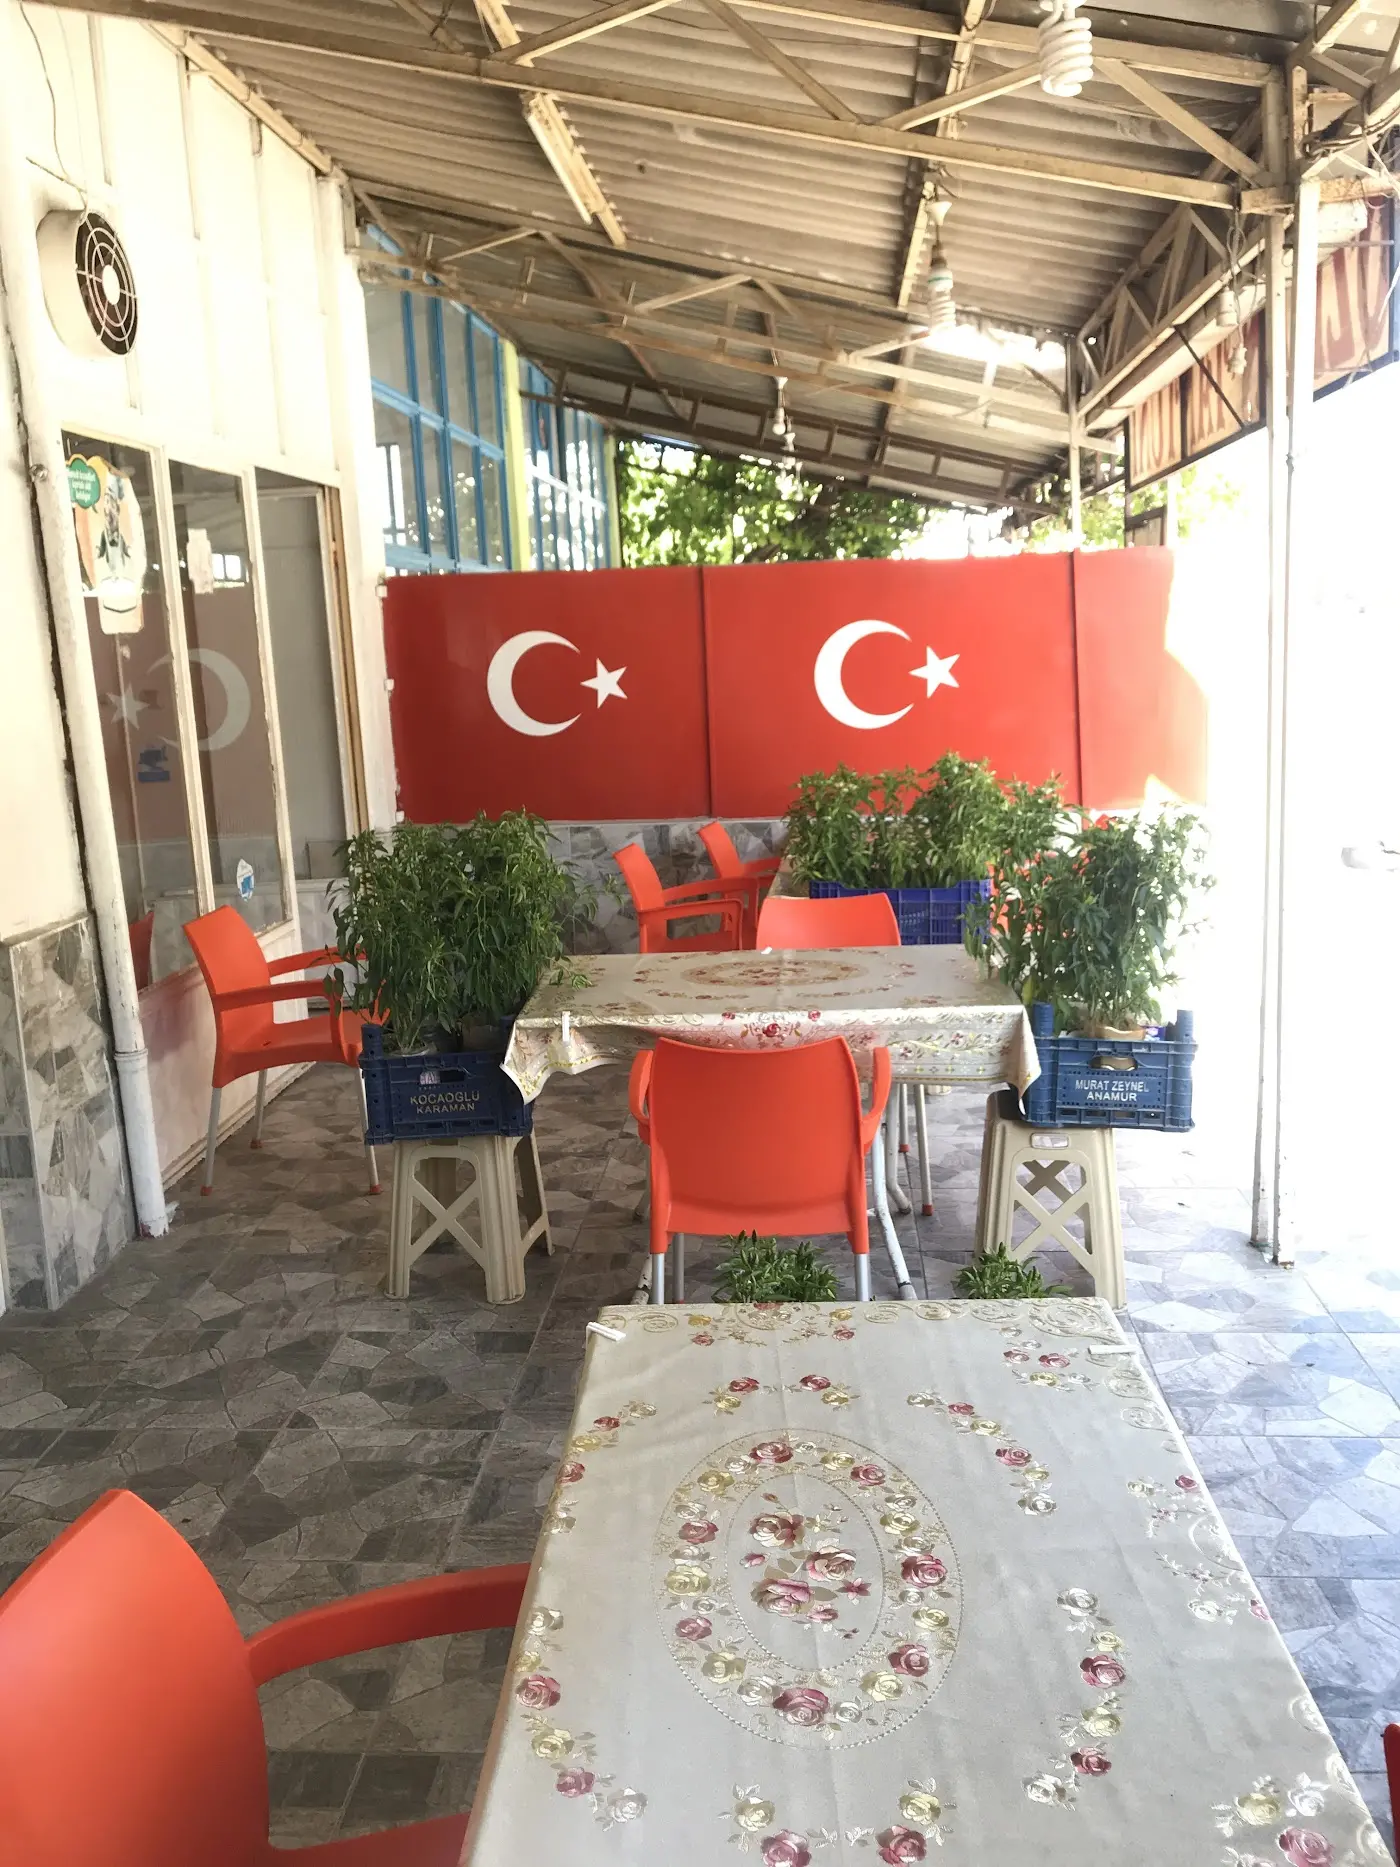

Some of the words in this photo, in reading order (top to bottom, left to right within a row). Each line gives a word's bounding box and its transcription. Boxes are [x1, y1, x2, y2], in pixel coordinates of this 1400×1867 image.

[1075, 1080, 1110, 1091] MURAT
[1111, 1080, 1150, 1092] ZEYNEL
[1086, 1091, 1137, 1102] ANAMUR
[416, 1102, 475, 1114] KARAMAN
